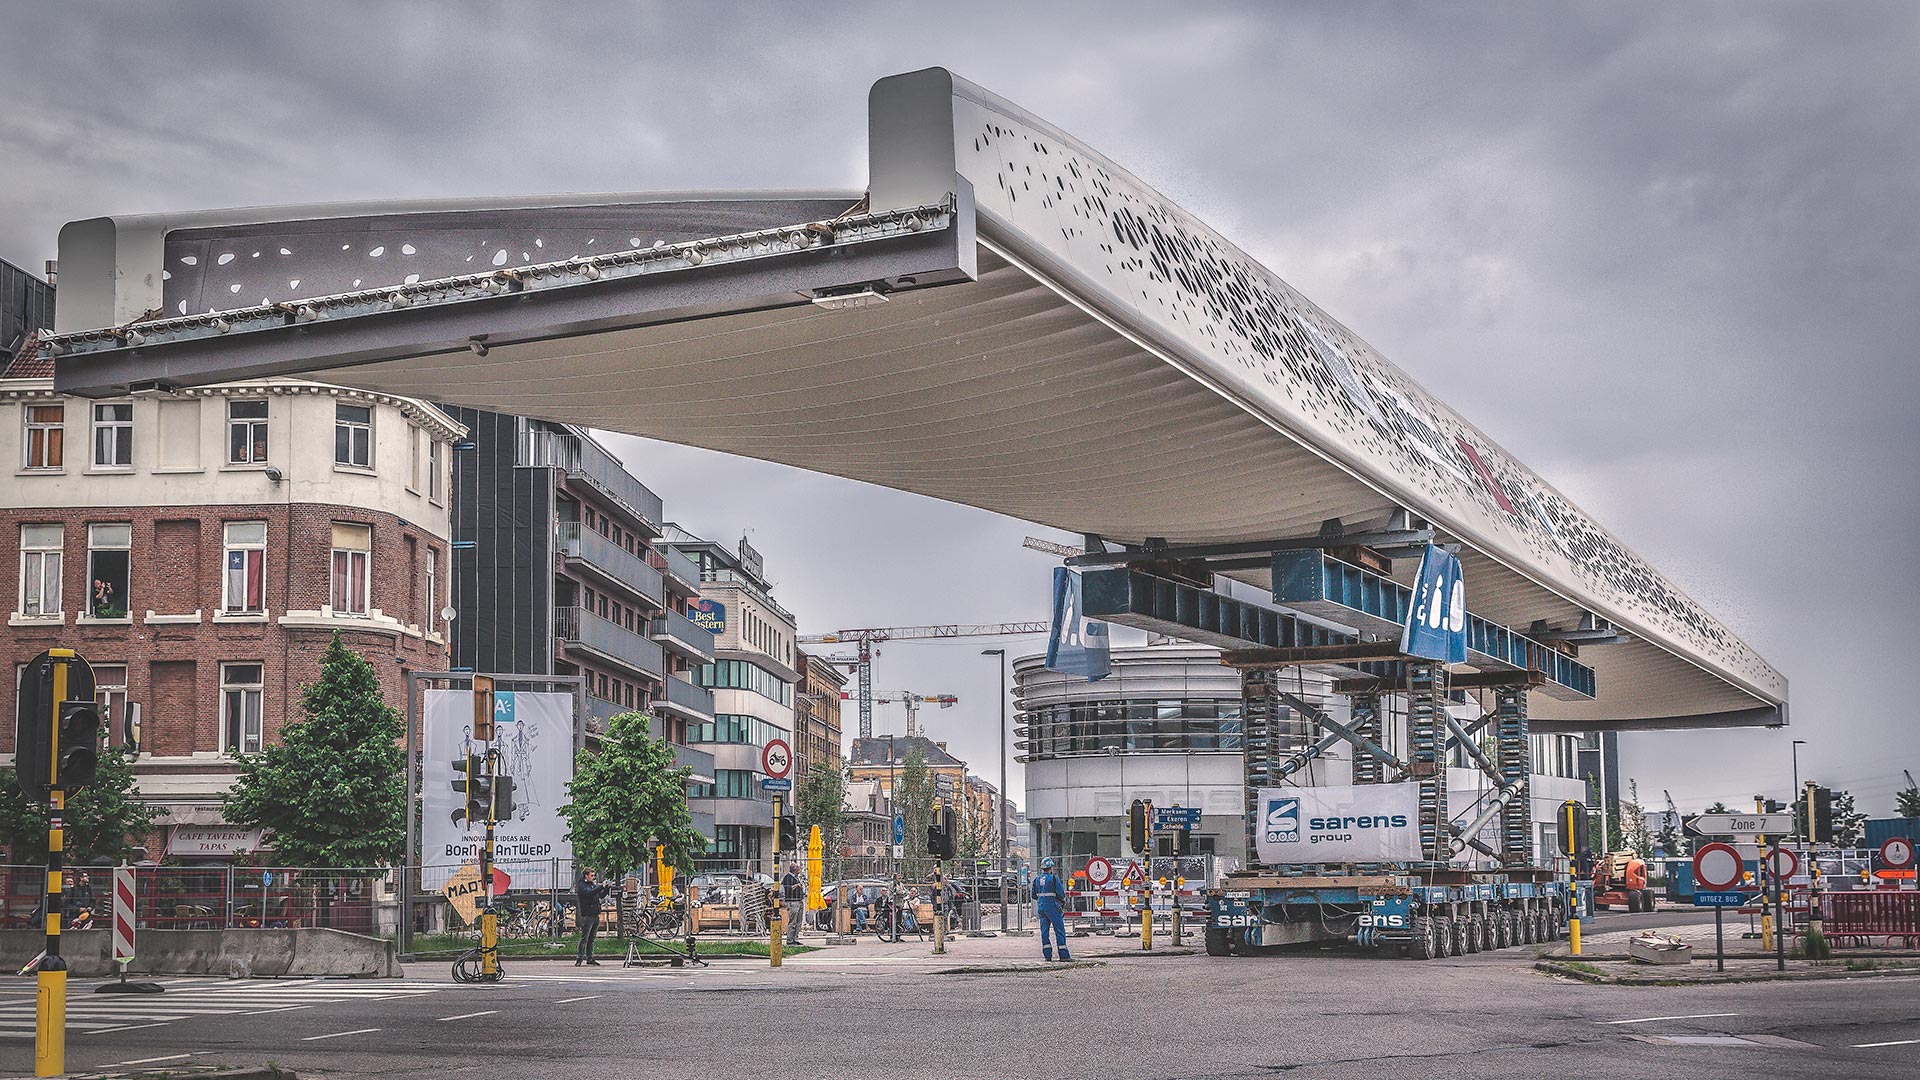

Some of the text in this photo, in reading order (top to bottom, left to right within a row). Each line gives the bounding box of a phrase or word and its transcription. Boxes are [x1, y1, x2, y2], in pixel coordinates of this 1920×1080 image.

[695, 611, 716, 621] Best
[692, 620, 724, 629] estern
[1309, 814, 1408, 831] sarens
[1730, 818, 1767, 830] Zone 7
[179, 832, 248, 840] CAFE TAVERNE
[1310, 833, 1352, 844] group
[1725, 895, 1738, 903] BUS
[1358, 914, 1403, 927] ens
